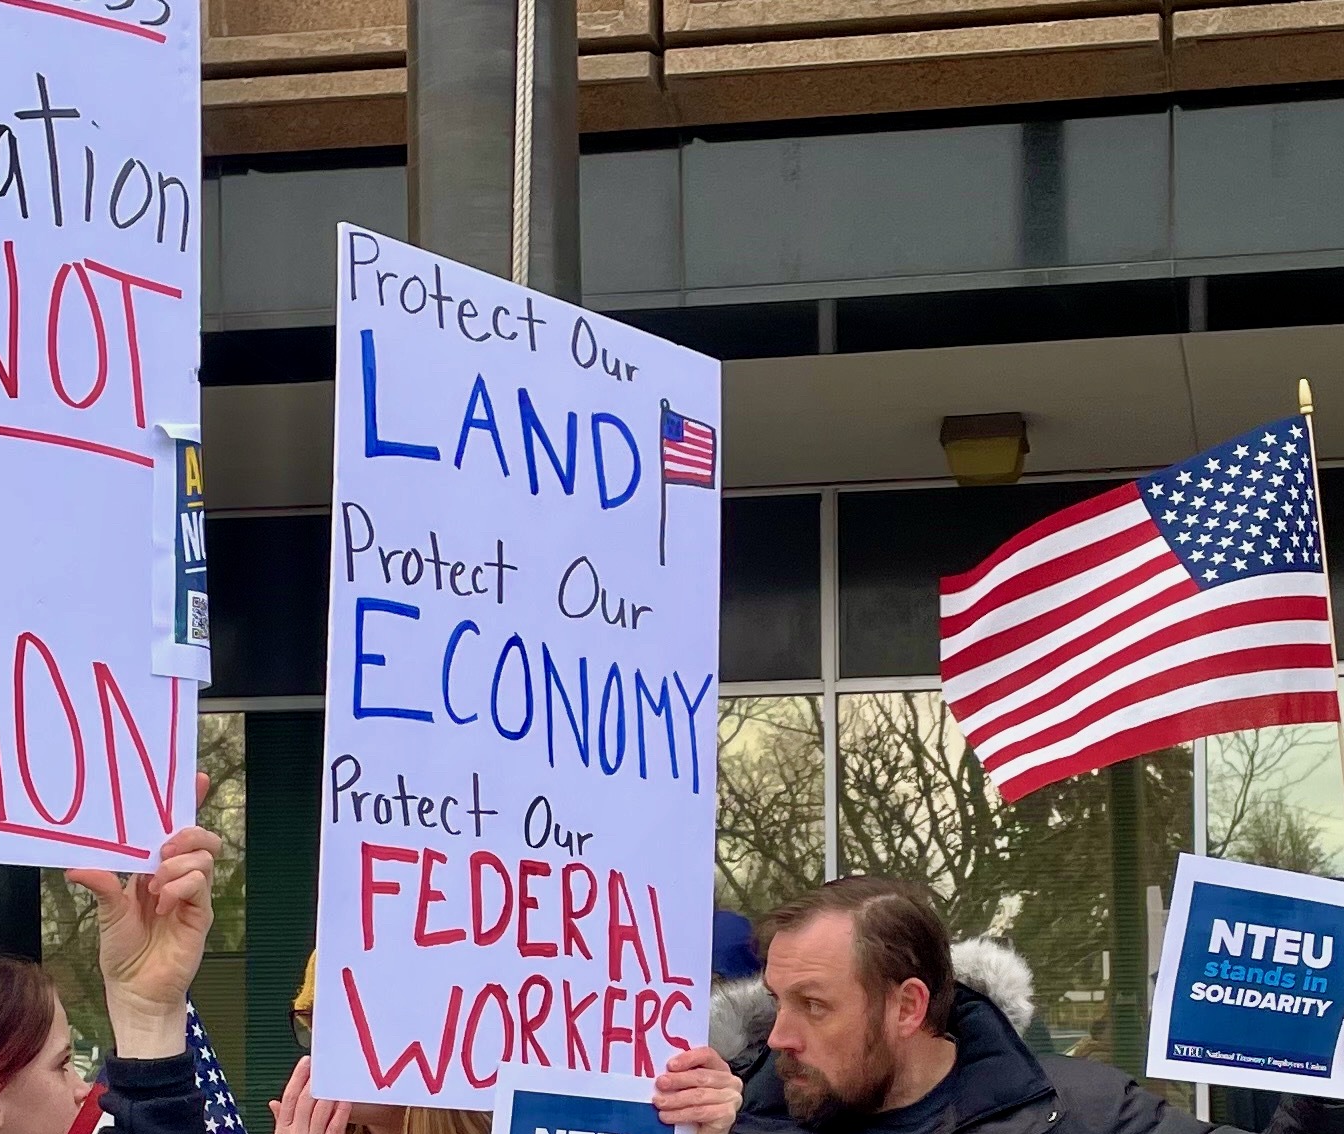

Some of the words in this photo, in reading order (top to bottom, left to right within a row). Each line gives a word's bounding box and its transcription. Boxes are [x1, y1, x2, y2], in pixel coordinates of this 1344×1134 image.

[349, 232, 546, 351] Protect
[571, 316, 640, 382] Our
[361, 329, 642, 510] LAND
[342, 502, 518, 604] Protect
[558, 555, 654, 630] Our
[353, 597, 713, 794] ECONOMY
[331, 753, 498, 837] Protect
[524, 795, 593, 857] Our
[361, 841, 694, 986] FEDERAL
[1204, 959, 1296, 989] stands
[1303, 969, 1328, 993] in
[1208, 918, 1334, 970] NTEU
[342, 967, 693, 1096] WORKERS
[1172, 1043, 1205, 1058] NTEU
[1206, 1049, 1235, 1061] National
[1190, 981, 1334, 1018] SOLIDARITY
